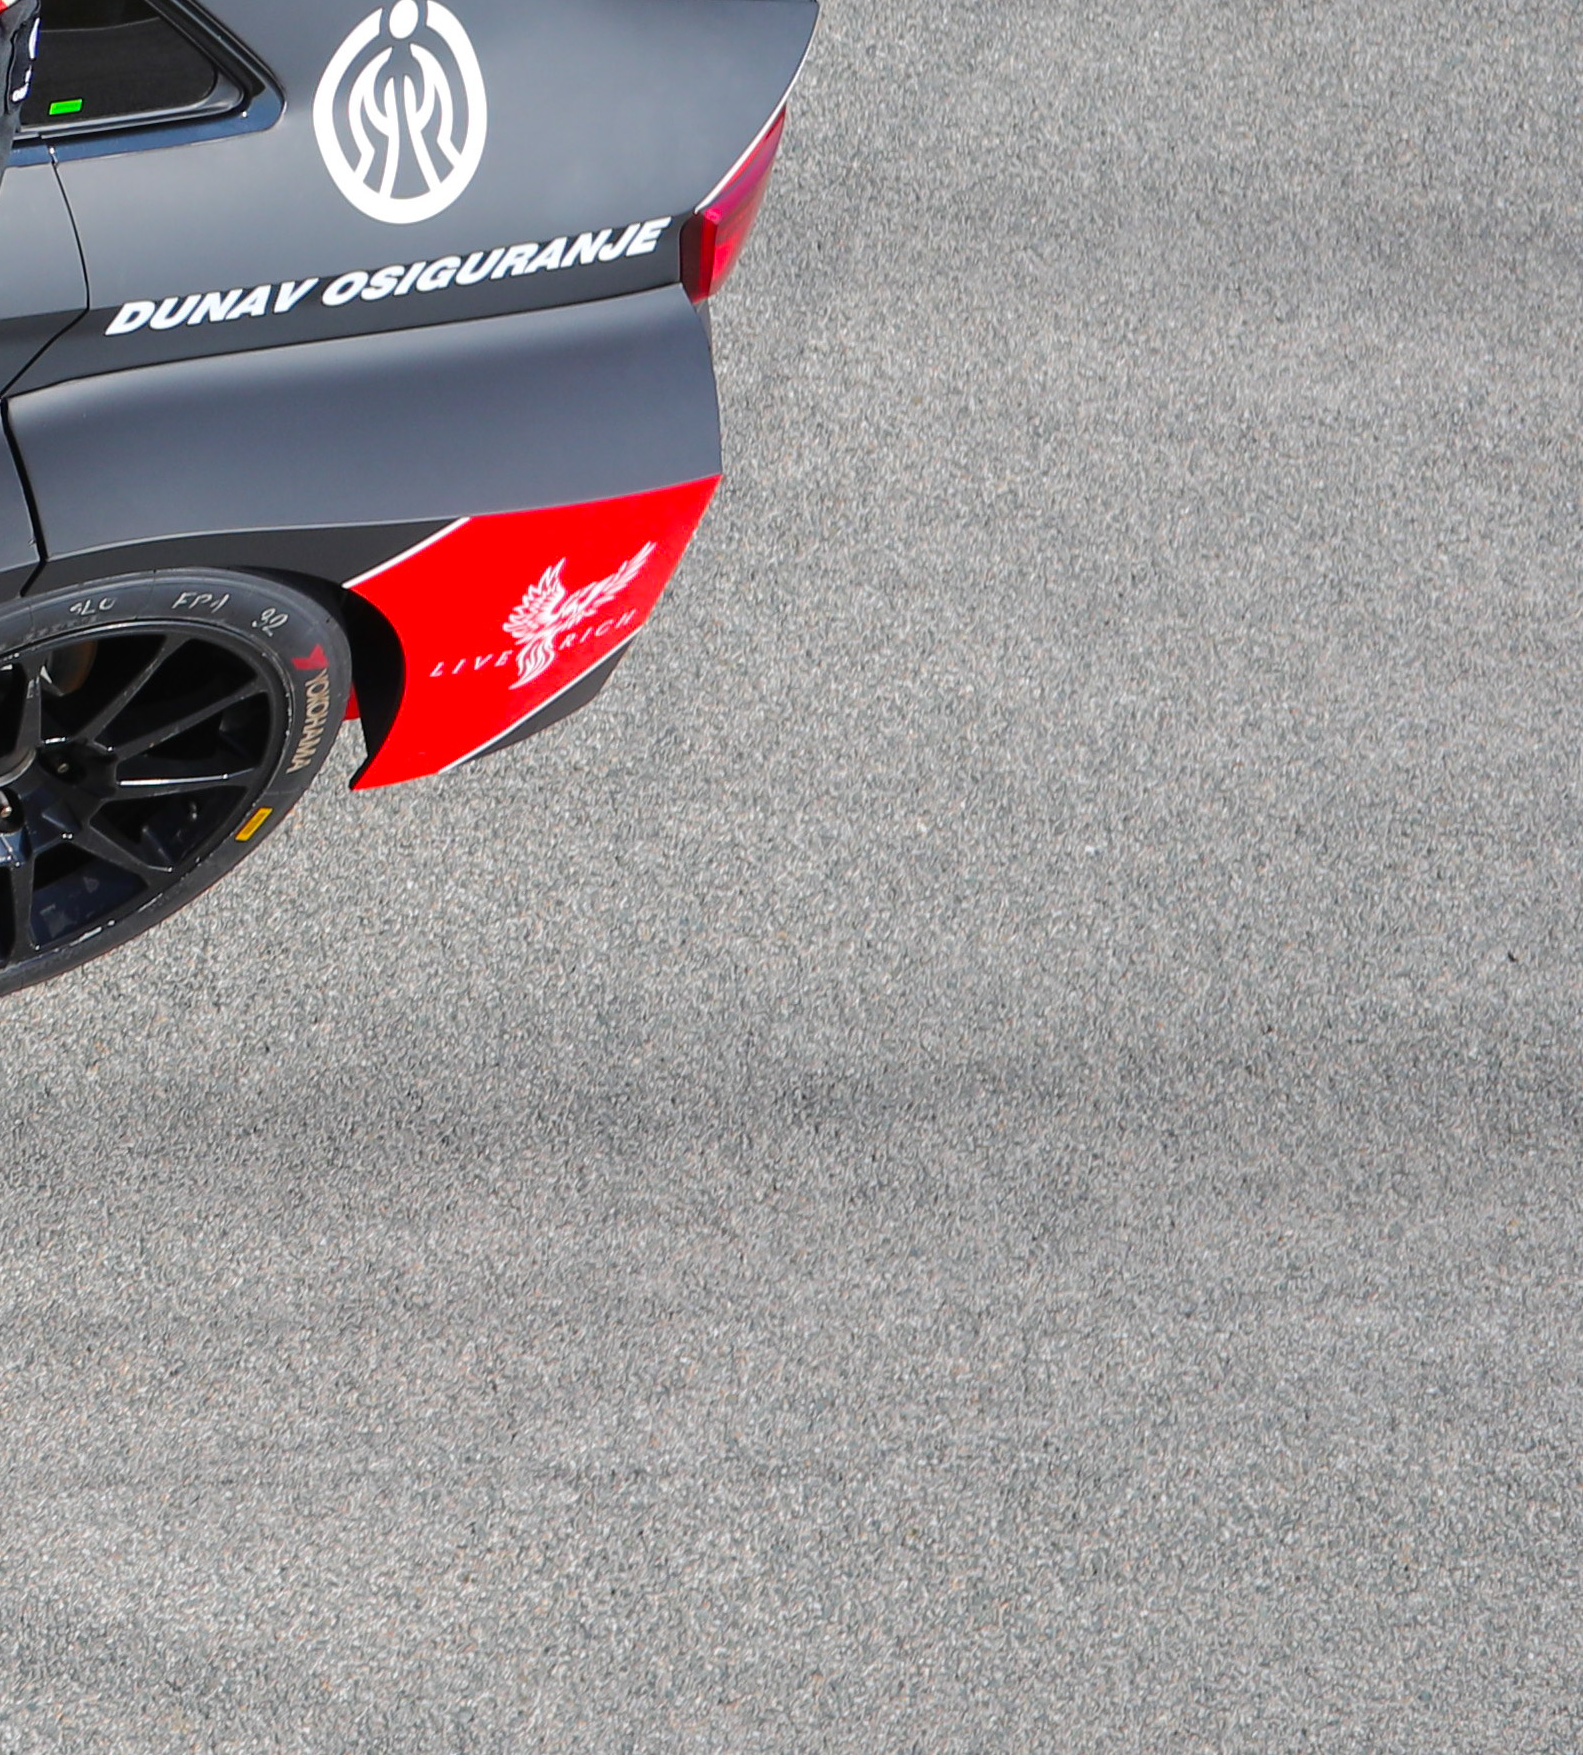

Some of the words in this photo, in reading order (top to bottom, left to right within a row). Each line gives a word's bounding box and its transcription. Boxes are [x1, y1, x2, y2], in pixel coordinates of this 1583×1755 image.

[104, 278, 318, 335] DUNAV
[321, 217, 672, 307] OSIGURANJE
[430, 650, 513, 677] LIVE
[286, 669, 330, 774] YOKOHAMA
